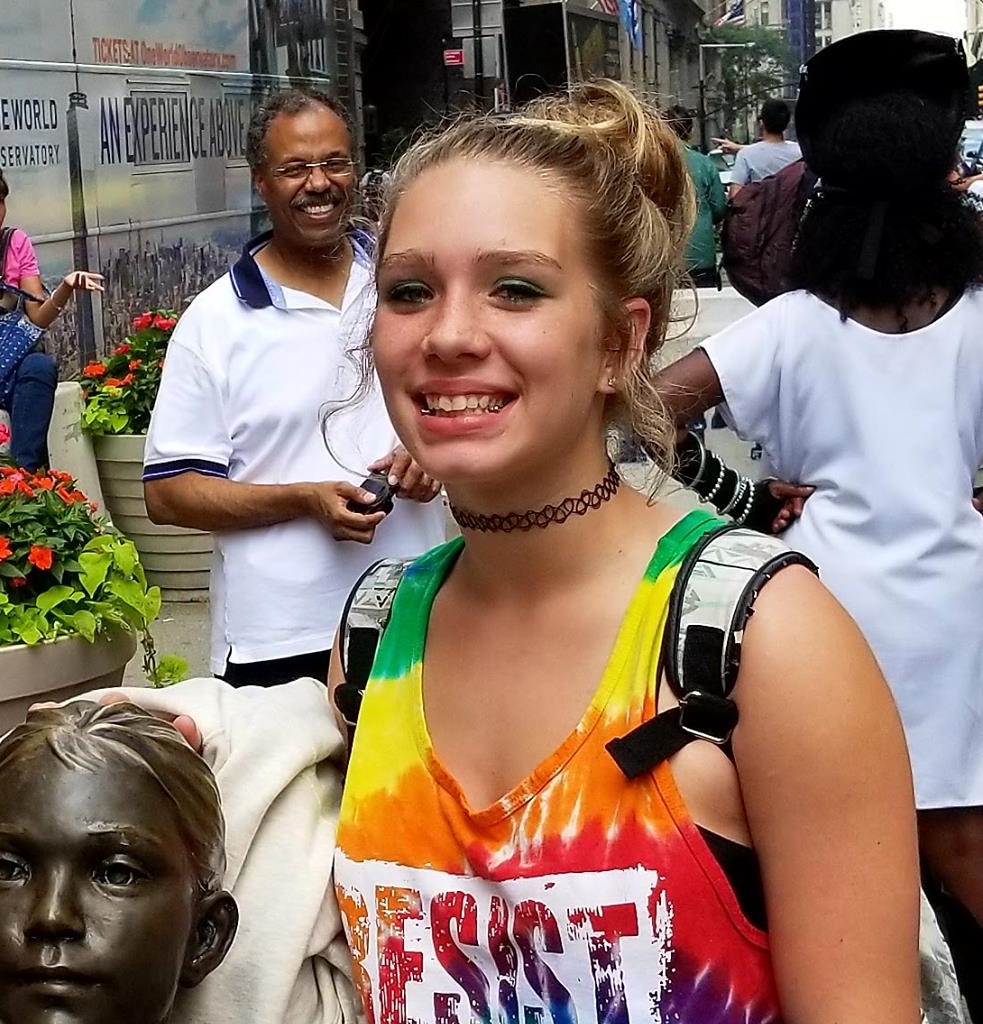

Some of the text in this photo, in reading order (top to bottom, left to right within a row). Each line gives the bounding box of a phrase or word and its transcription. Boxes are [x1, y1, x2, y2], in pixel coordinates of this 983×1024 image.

[10, 98, 57, 130] WORLD
[101, 97, 247, 165] AN EXPERIENCE ABOVE
